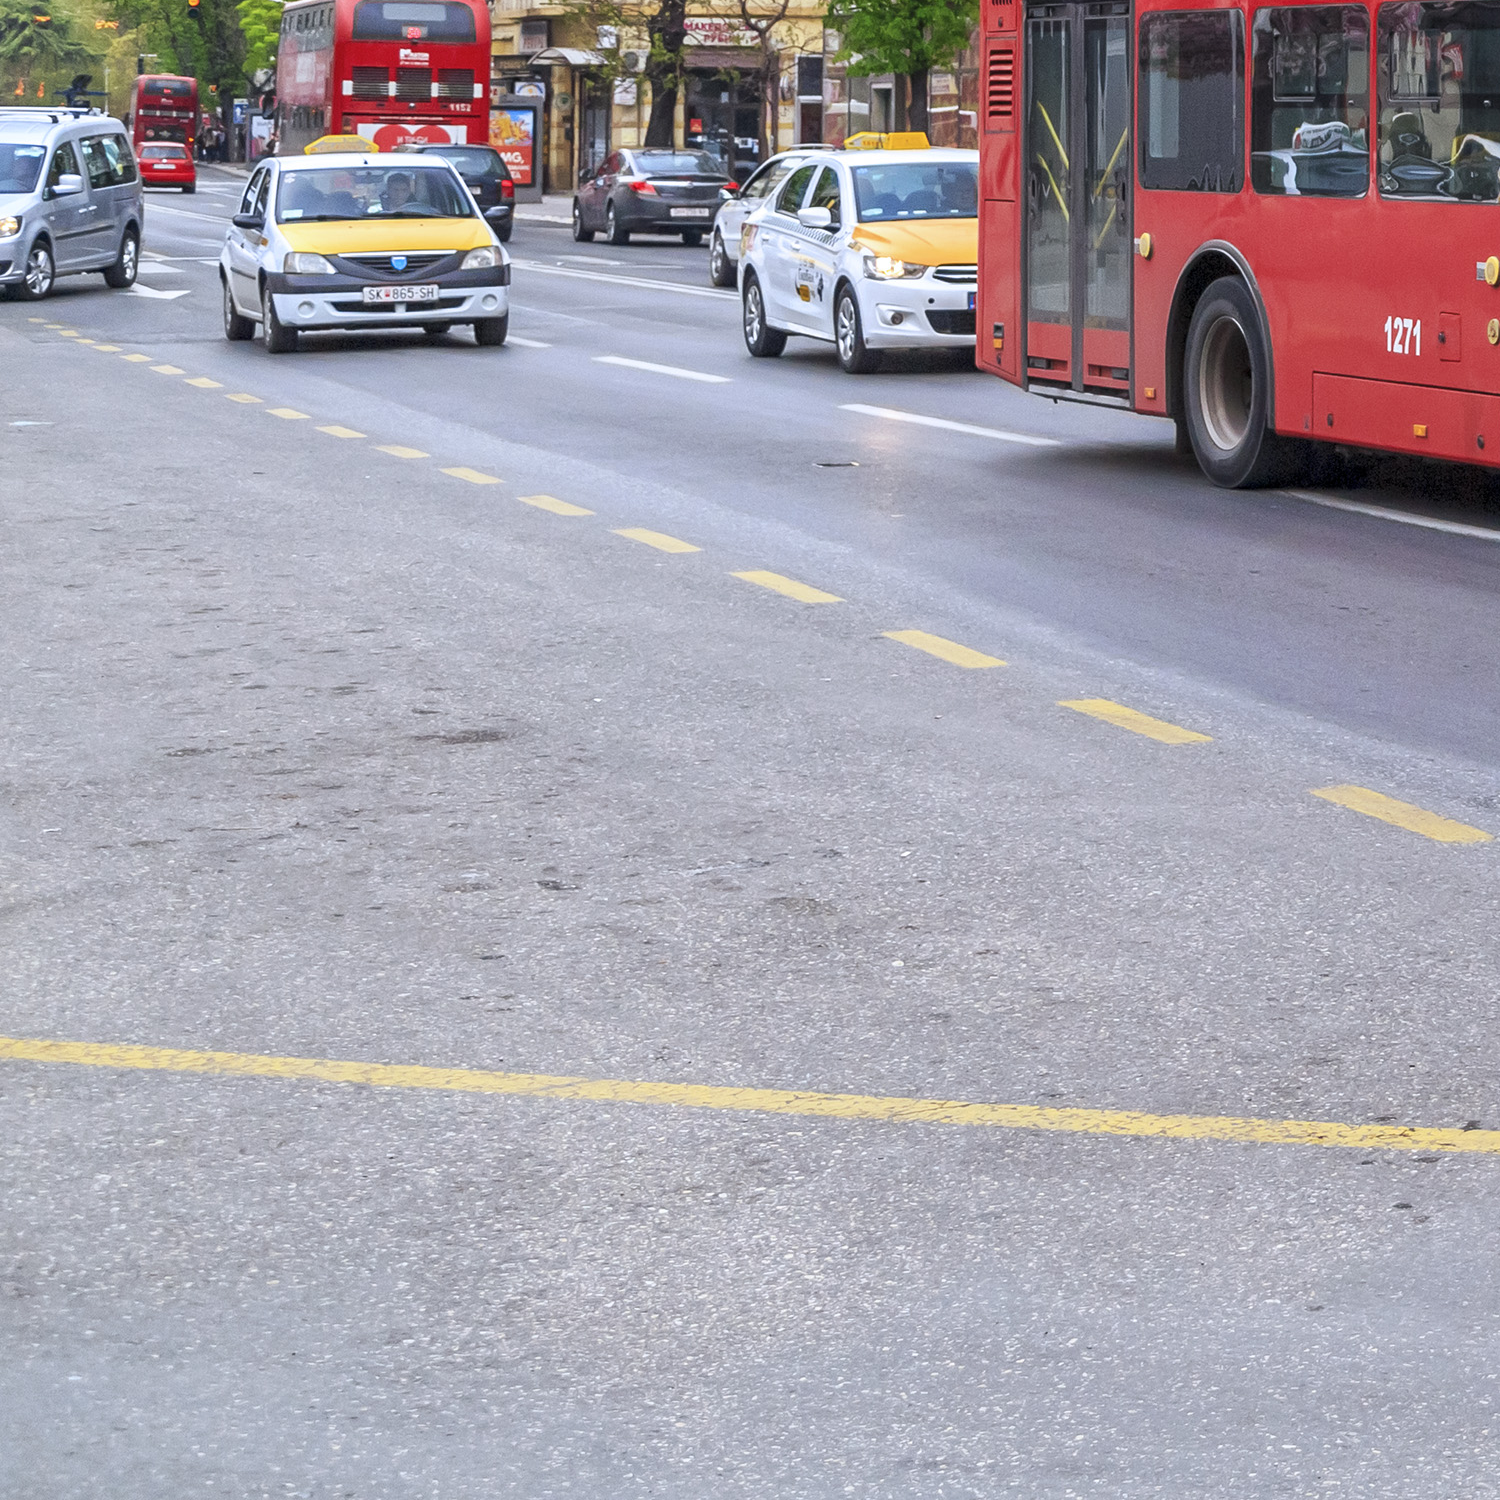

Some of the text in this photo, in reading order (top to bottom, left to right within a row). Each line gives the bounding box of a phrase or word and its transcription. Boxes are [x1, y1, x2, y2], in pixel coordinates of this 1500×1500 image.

[368, 287, 434, 301] SK 865-SH
[1384, 315, 1422, 357] 1271
